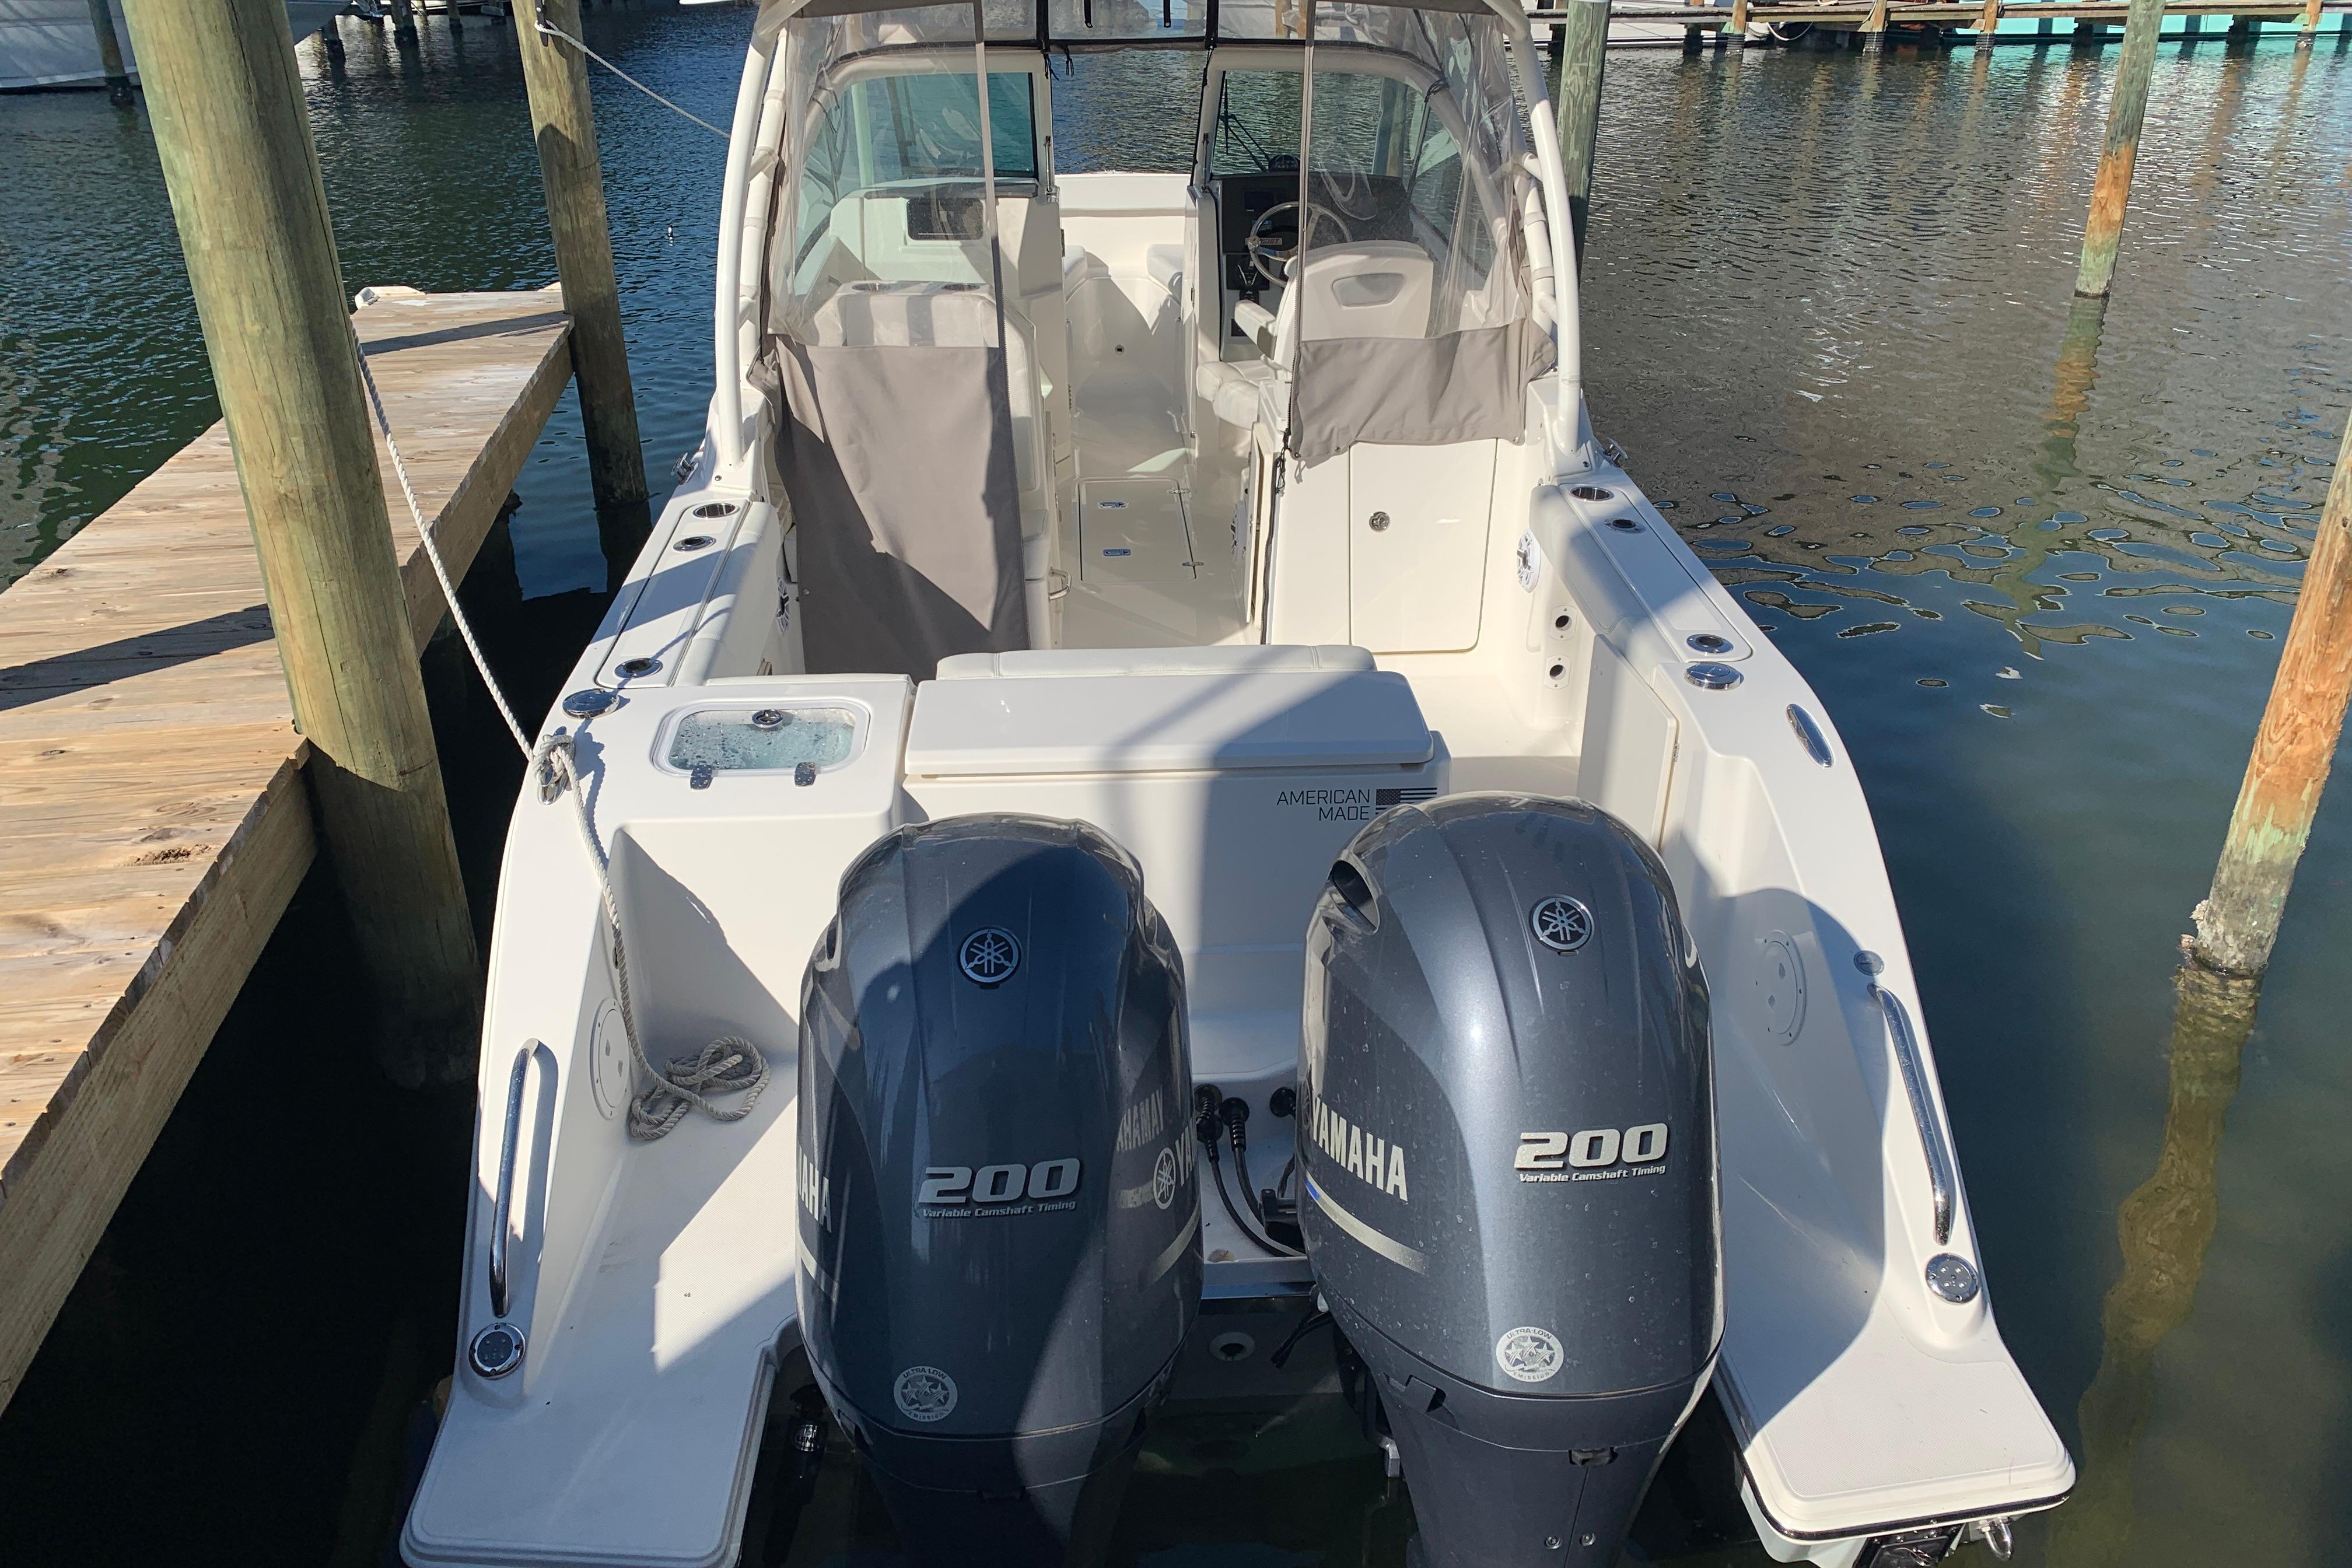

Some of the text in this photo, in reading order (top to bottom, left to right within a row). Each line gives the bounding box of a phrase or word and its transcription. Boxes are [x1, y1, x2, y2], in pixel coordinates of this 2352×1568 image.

[1276, 789, 1370, 806] AMERICAN
[1319, 806, 1370, 821] MADE
[1312, 1097, 1408, 1202] YAMAHA
[1514, 1123, 1668, 1168] 200
[918, 1158, 1080, 1203] 200
[1520, 1166, 1666, 1182] Variable Camshaft Timing
[923, 1201, 1076, 1217] Variable Camshaft Timing
[1513, 1371, 1550, 1380] EMISSION
